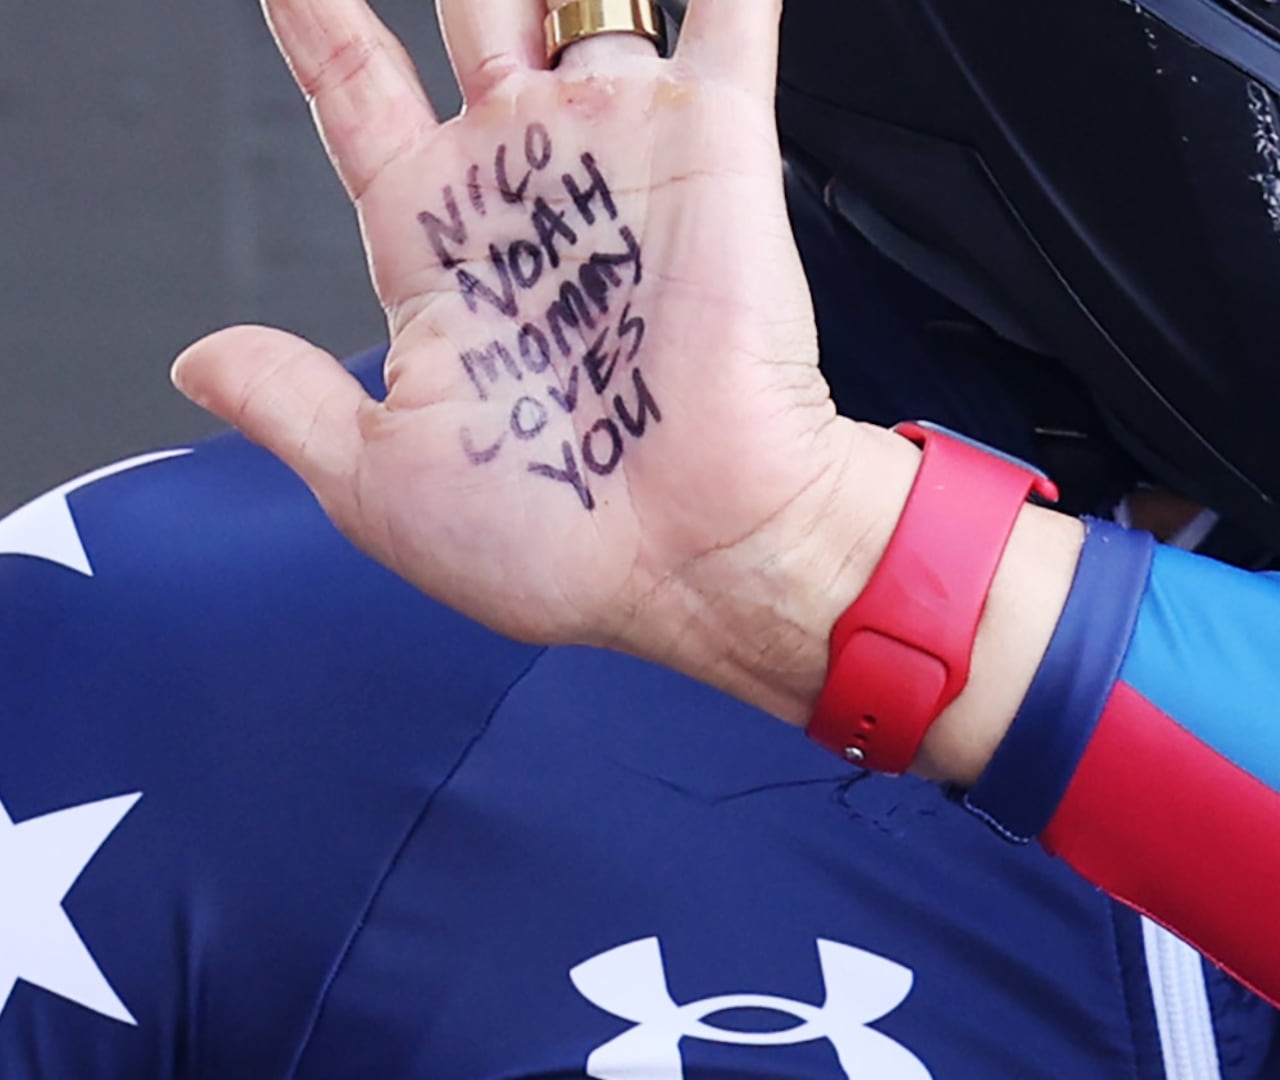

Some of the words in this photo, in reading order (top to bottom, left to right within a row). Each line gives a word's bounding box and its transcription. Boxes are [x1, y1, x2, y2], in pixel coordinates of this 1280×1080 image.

[417, 122, 552, 270] NICO
[452, 151, 618, 318] NOAH
[459, 301, 646, 466] LOVES
[460, 225, 643, 402] MOMMY
[527, 367, 663, 512] YOU
